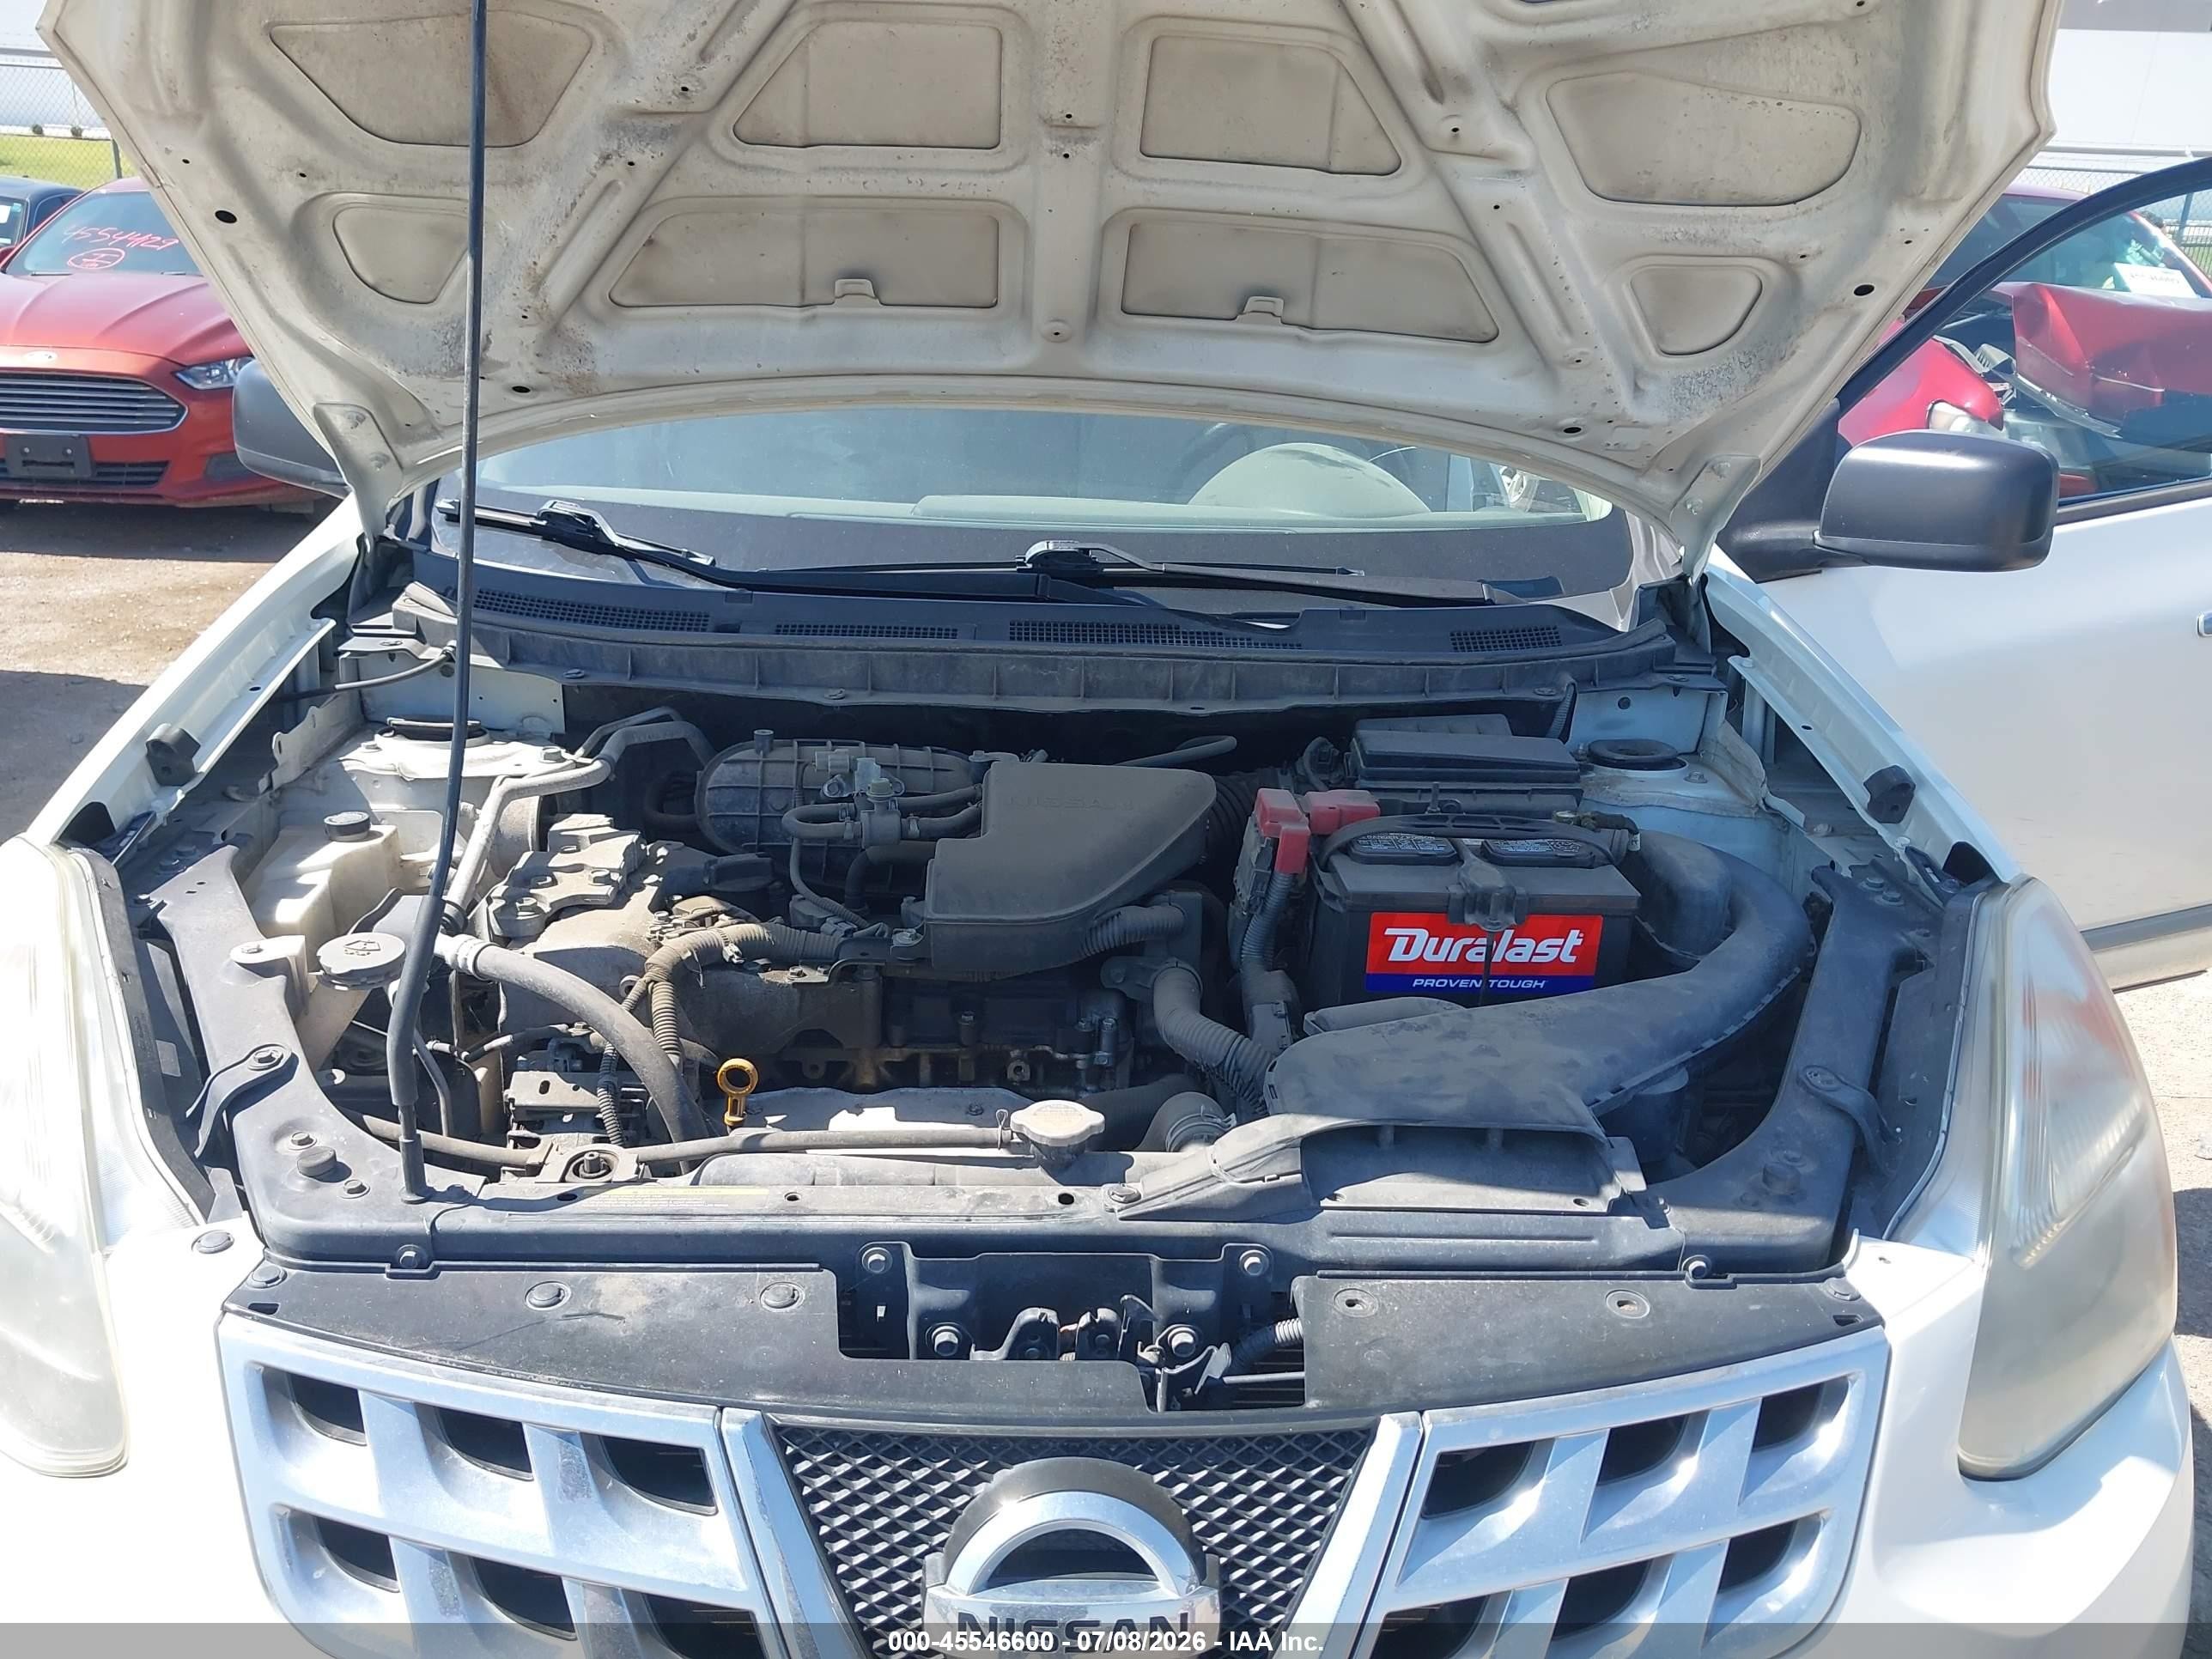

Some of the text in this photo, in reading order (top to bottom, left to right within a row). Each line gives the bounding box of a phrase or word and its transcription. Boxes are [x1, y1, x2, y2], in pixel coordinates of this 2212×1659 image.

[1383, 927, 1583, 963] Duralast
[1413, 978, 1546, 988] PROVEN TOUGH
[957, 1611, 1190, 1654] NISSAN
